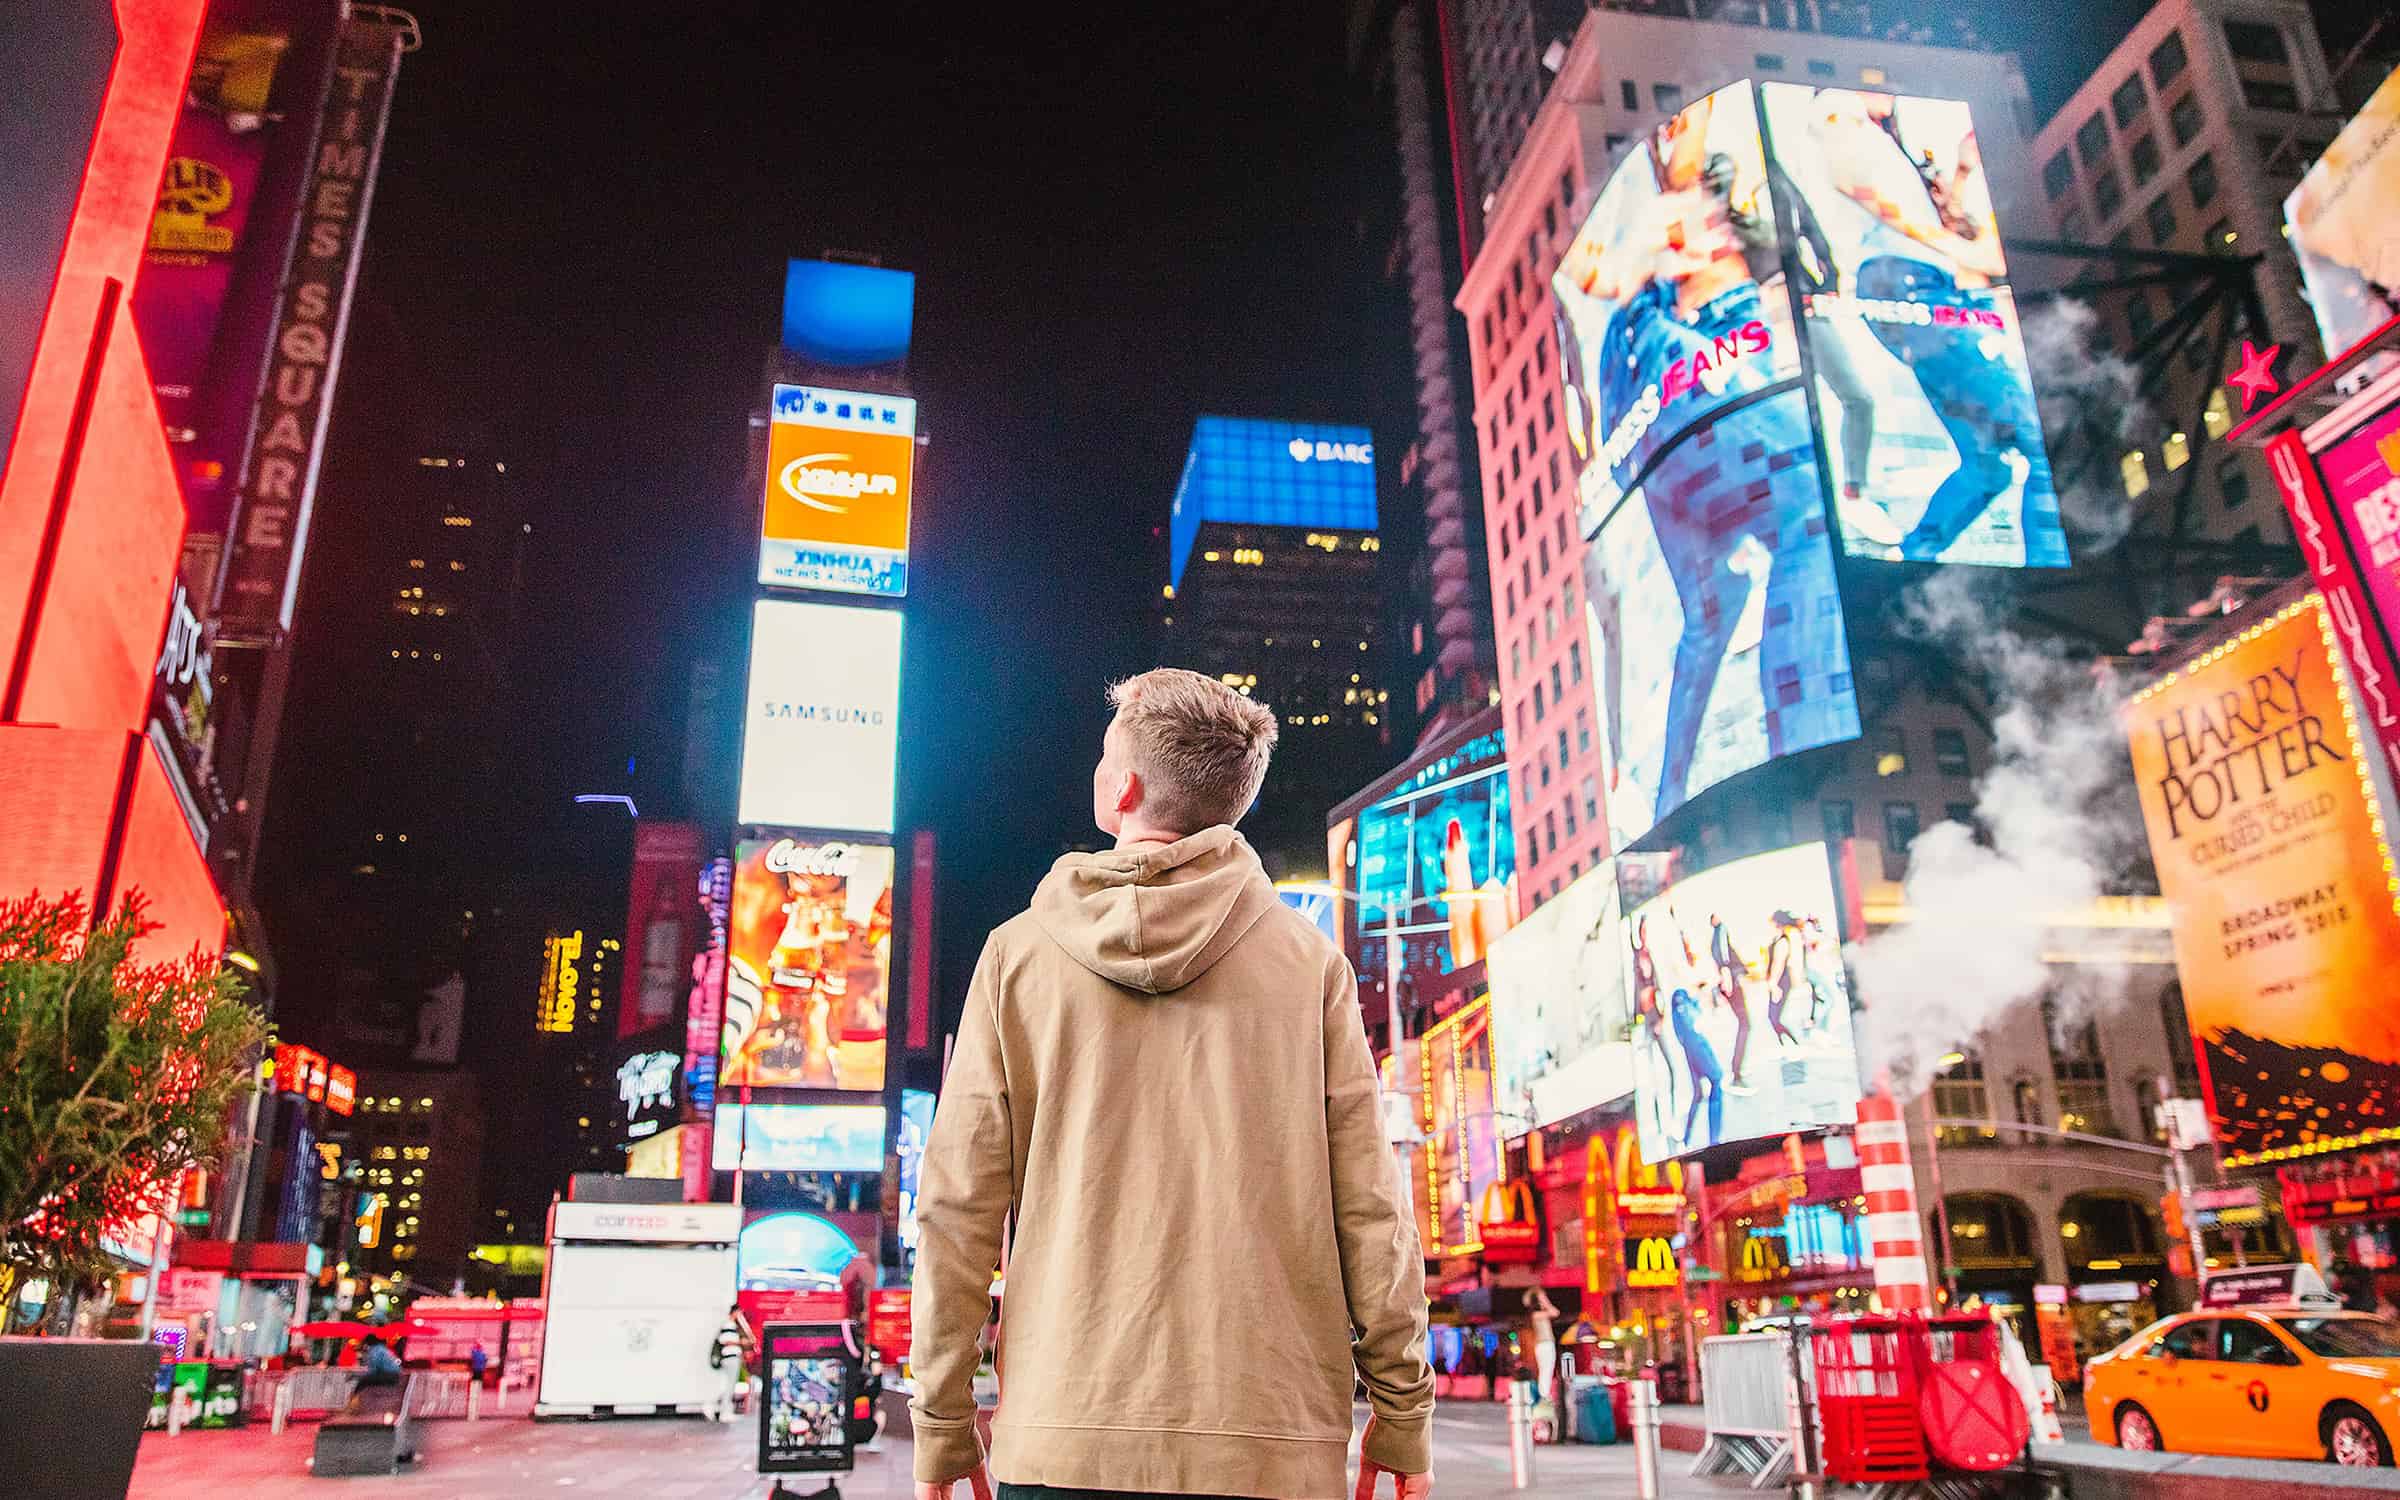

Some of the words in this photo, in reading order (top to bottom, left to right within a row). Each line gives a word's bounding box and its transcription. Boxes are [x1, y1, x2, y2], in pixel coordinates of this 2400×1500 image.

[308, 68, 380, 257] TIMES
[1660, 320, 1771, 408] JEANS
[247, 282, 331, 546] SQUARE
[1315, 441, 1374, 464] BARC
[764, 701, 884, 726] SAMSUNG
[2156, 649, 2308, 773] HARRY
[2159, 715, 2345, 840] POTTER
[2222, 881, 2338, 936] BROADWAY
[2222, 921, 2297, 961] SPRING
[551, 929, 583, 1033] NOVOTEL
